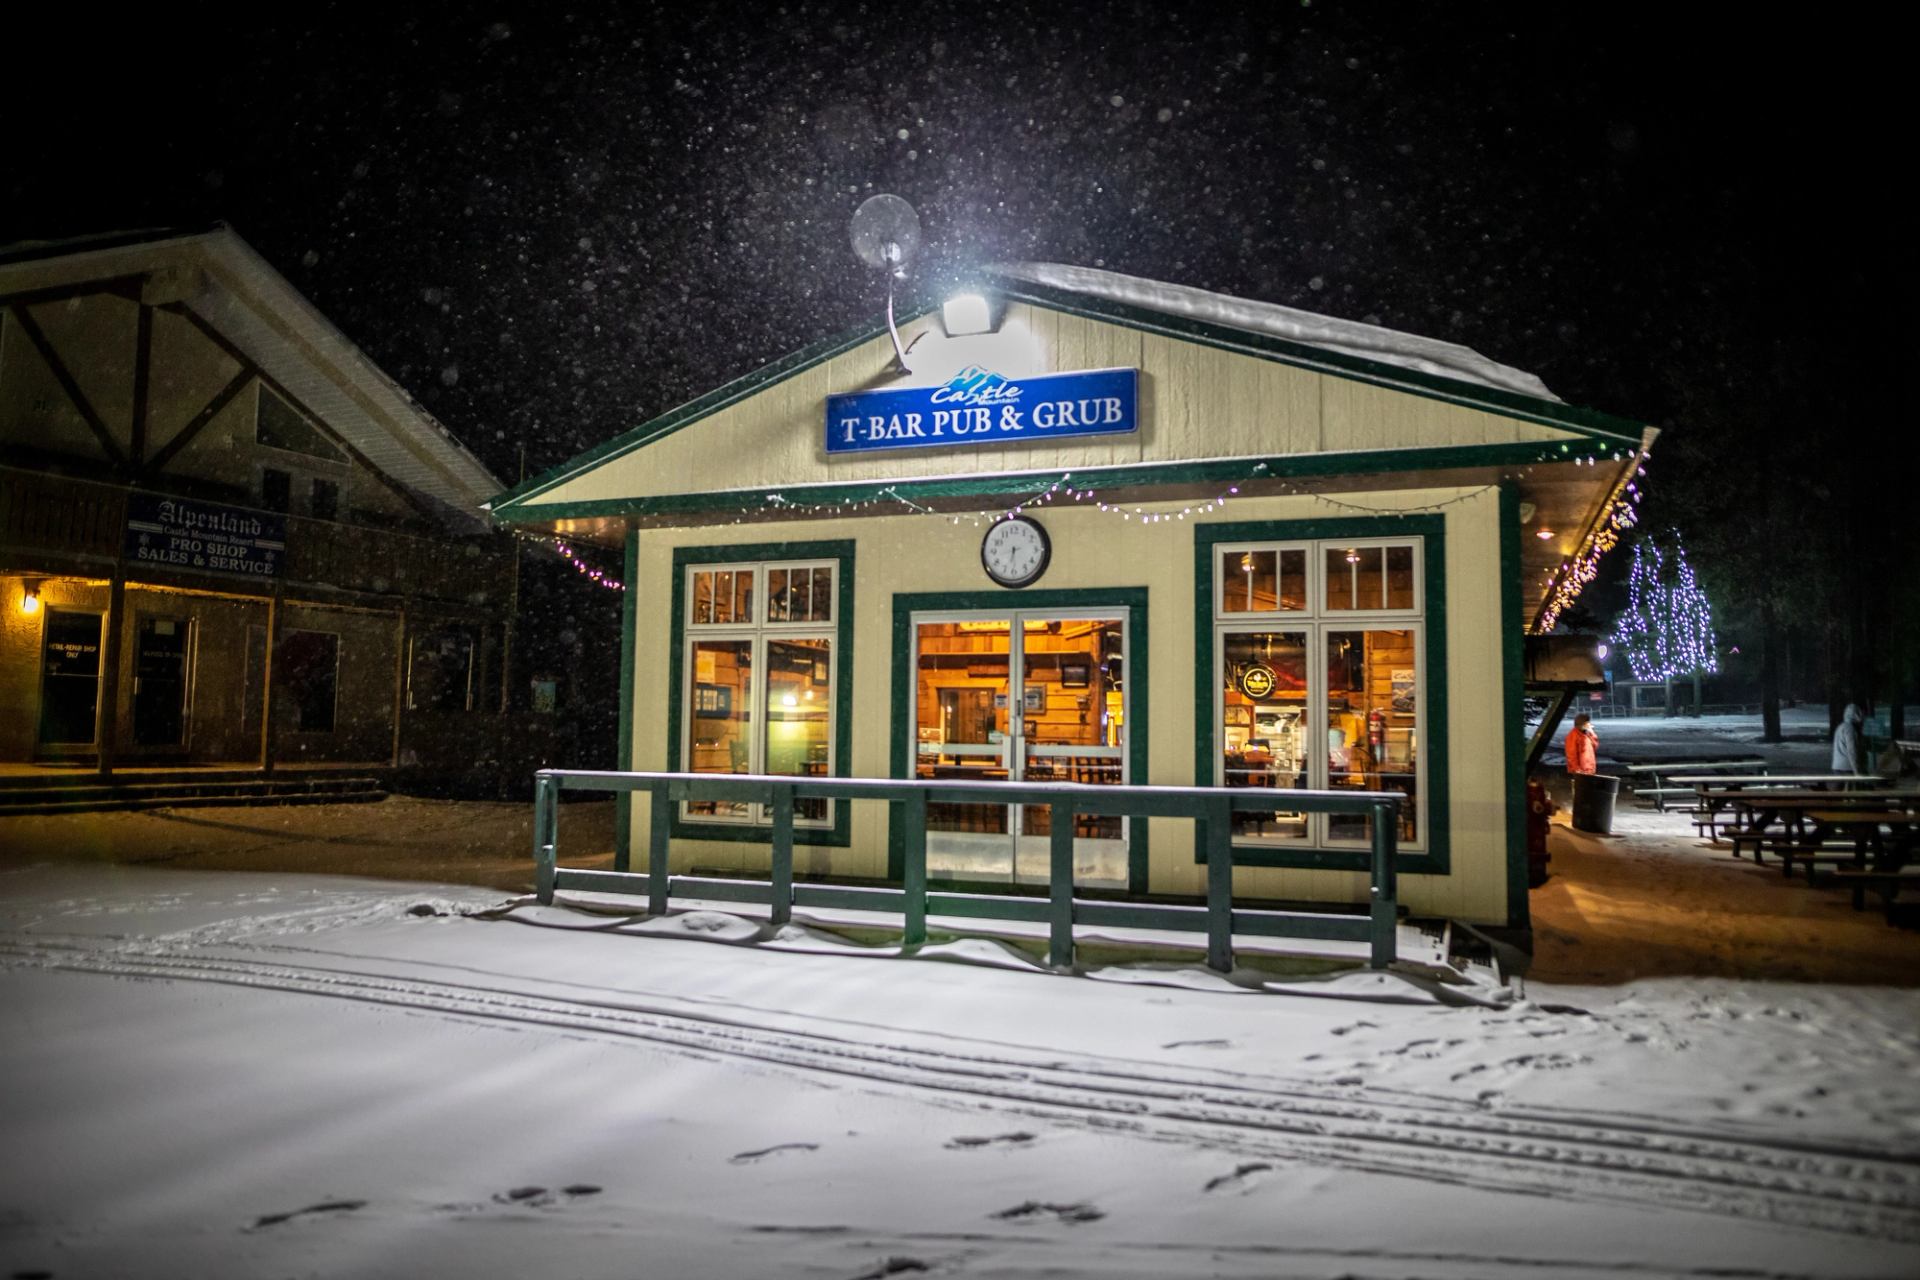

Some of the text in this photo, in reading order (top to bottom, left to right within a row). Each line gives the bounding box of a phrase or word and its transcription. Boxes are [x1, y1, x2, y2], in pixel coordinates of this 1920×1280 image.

[931, 380, 1024, 405] Castle
[841, 397, 1123, 442] T-BAR PUB & GRUB
[159, 501, 262, 536] Alpenland
[164, 525, 189, 537] Castle
[191, 529, 228, 543] Mountain
[138, 546, 275, 574] SALES & SERVICE
[171, 537, 248, 559] PRO SHOP
